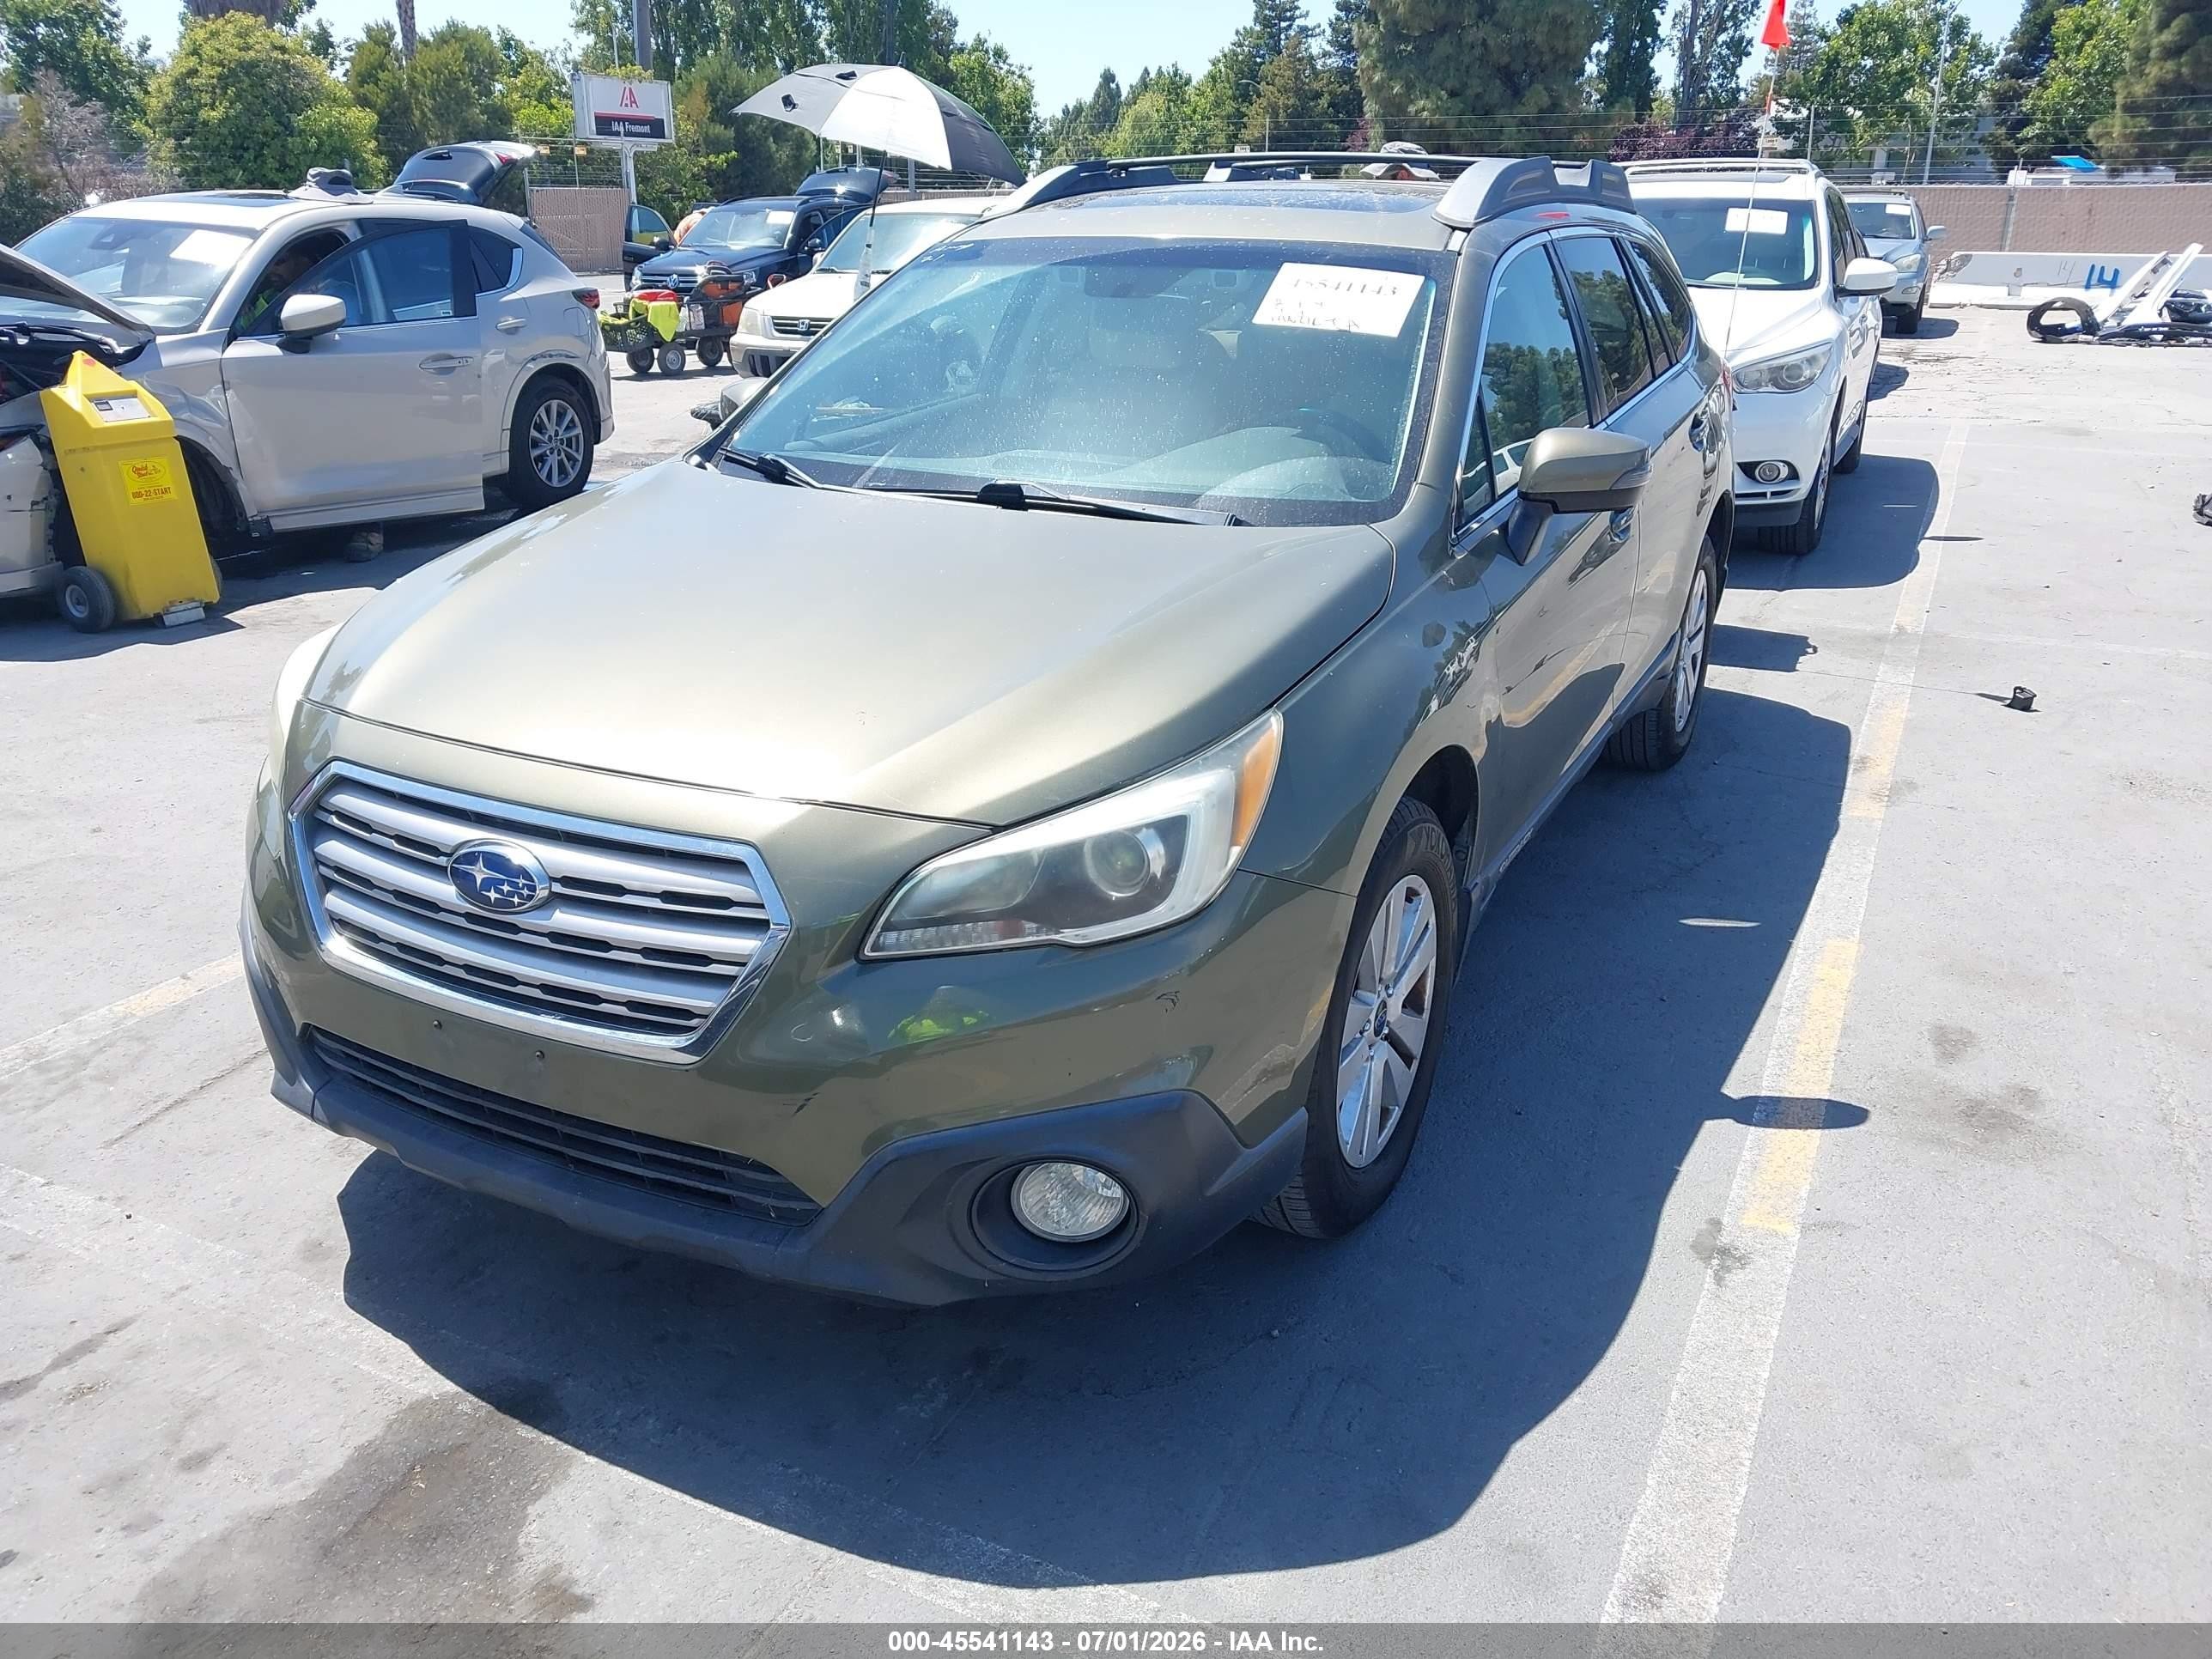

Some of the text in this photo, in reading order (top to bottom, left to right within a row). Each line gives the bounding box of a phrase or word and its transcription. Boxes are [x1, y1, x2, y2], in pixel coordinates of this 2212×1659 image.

[611, 120, 651, 134] IAA Fremont
[2084, 263, 2120, 295] 14
